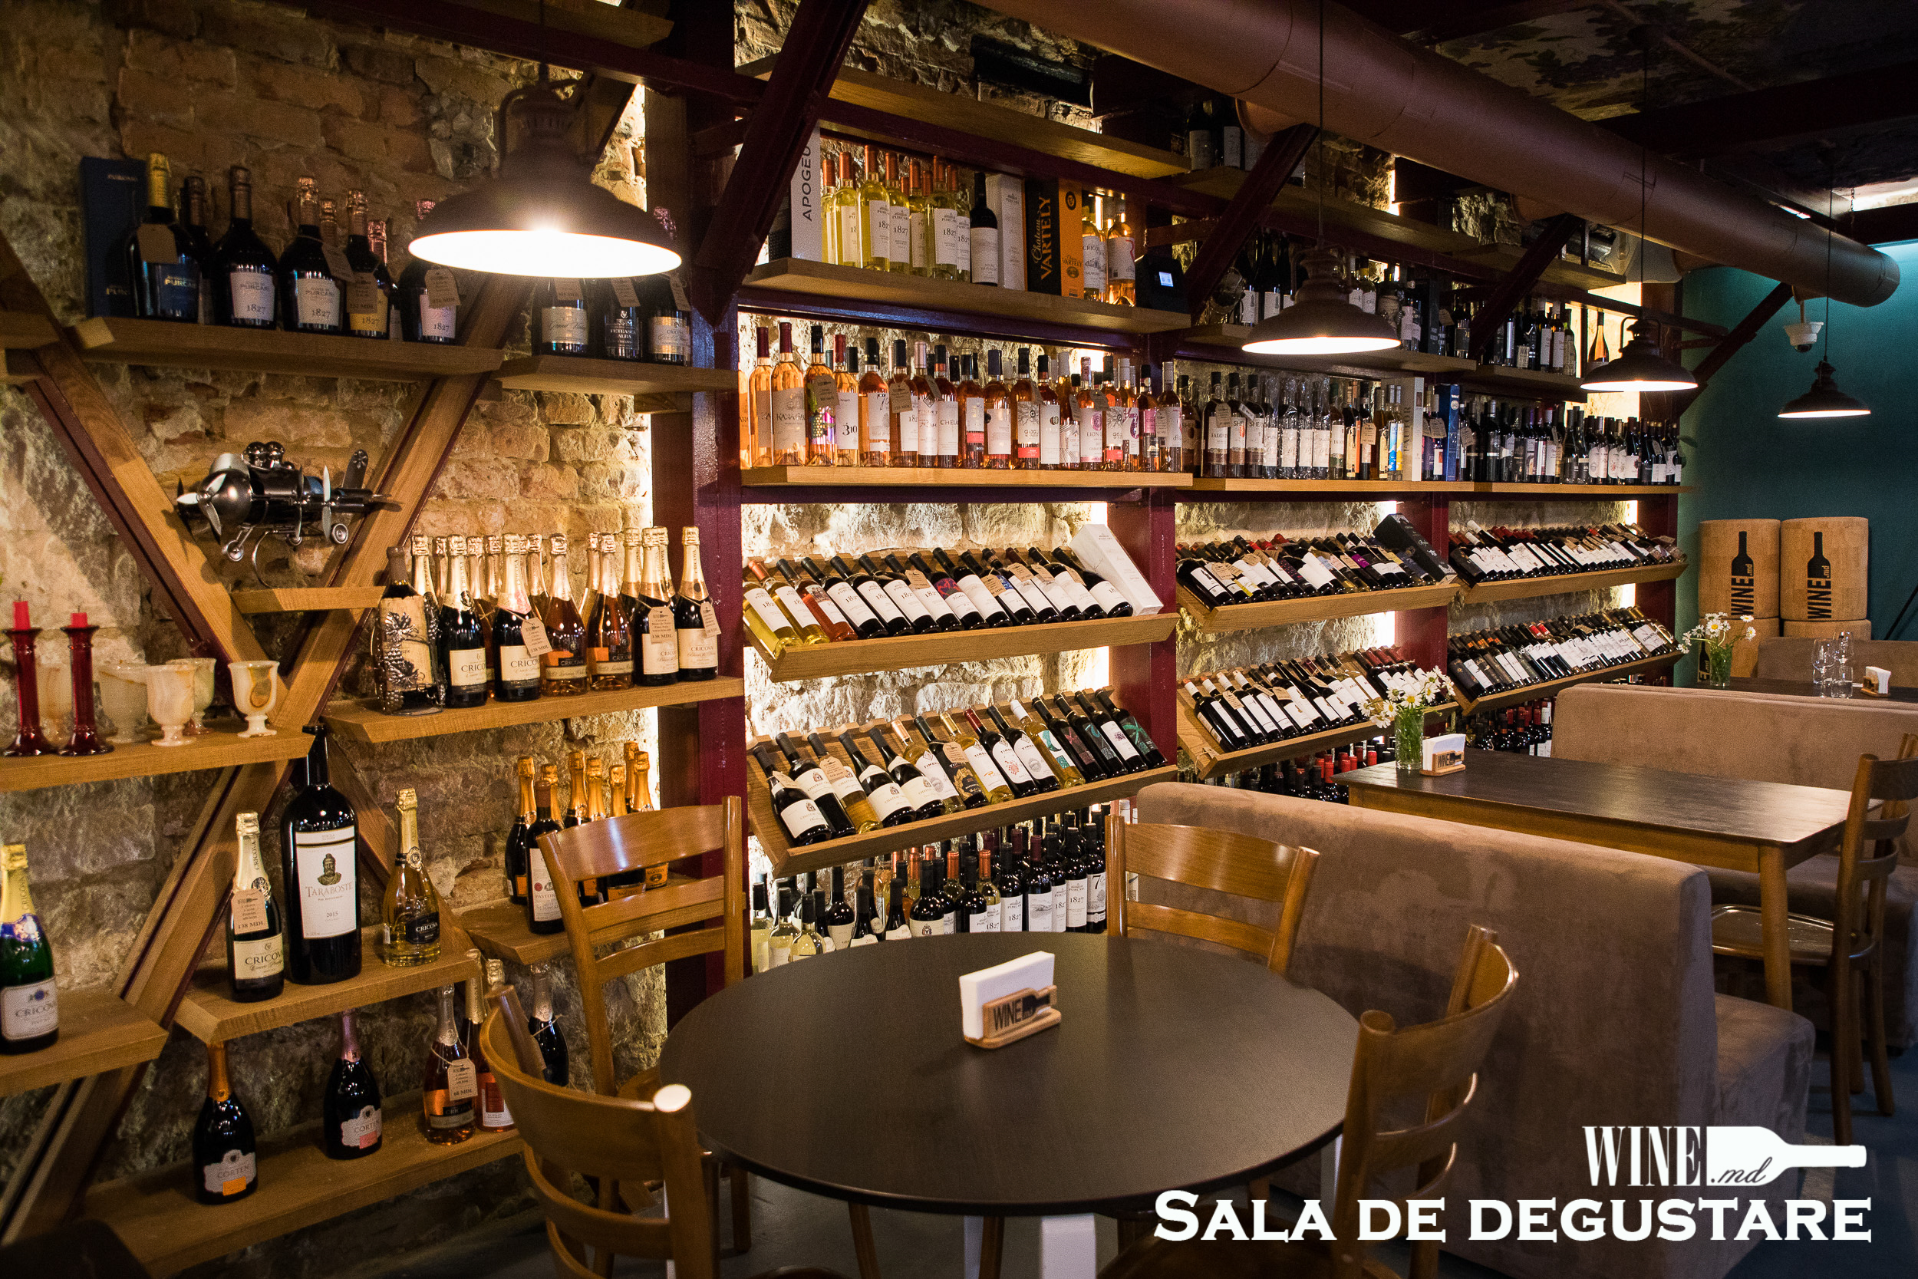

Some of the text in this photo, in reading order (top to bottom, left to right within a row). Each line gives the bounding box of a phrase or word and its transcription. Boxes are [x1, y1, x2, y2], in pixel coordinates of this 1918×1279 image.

[894, 226, 908, 236] 1827
[1038, 196, 1052, 280] VARTELY
[246, 304, 266, 314] 1827
[312, 308, 331, 318] 1827
[362, 316, 380, 325] 1827
[433, 323, 450, 331] 1827
[1731, 576, 1754, 616] WINE
[1807, 578, 1832, 620] WINE
[993, 1000, 1022, 1032] WINE
